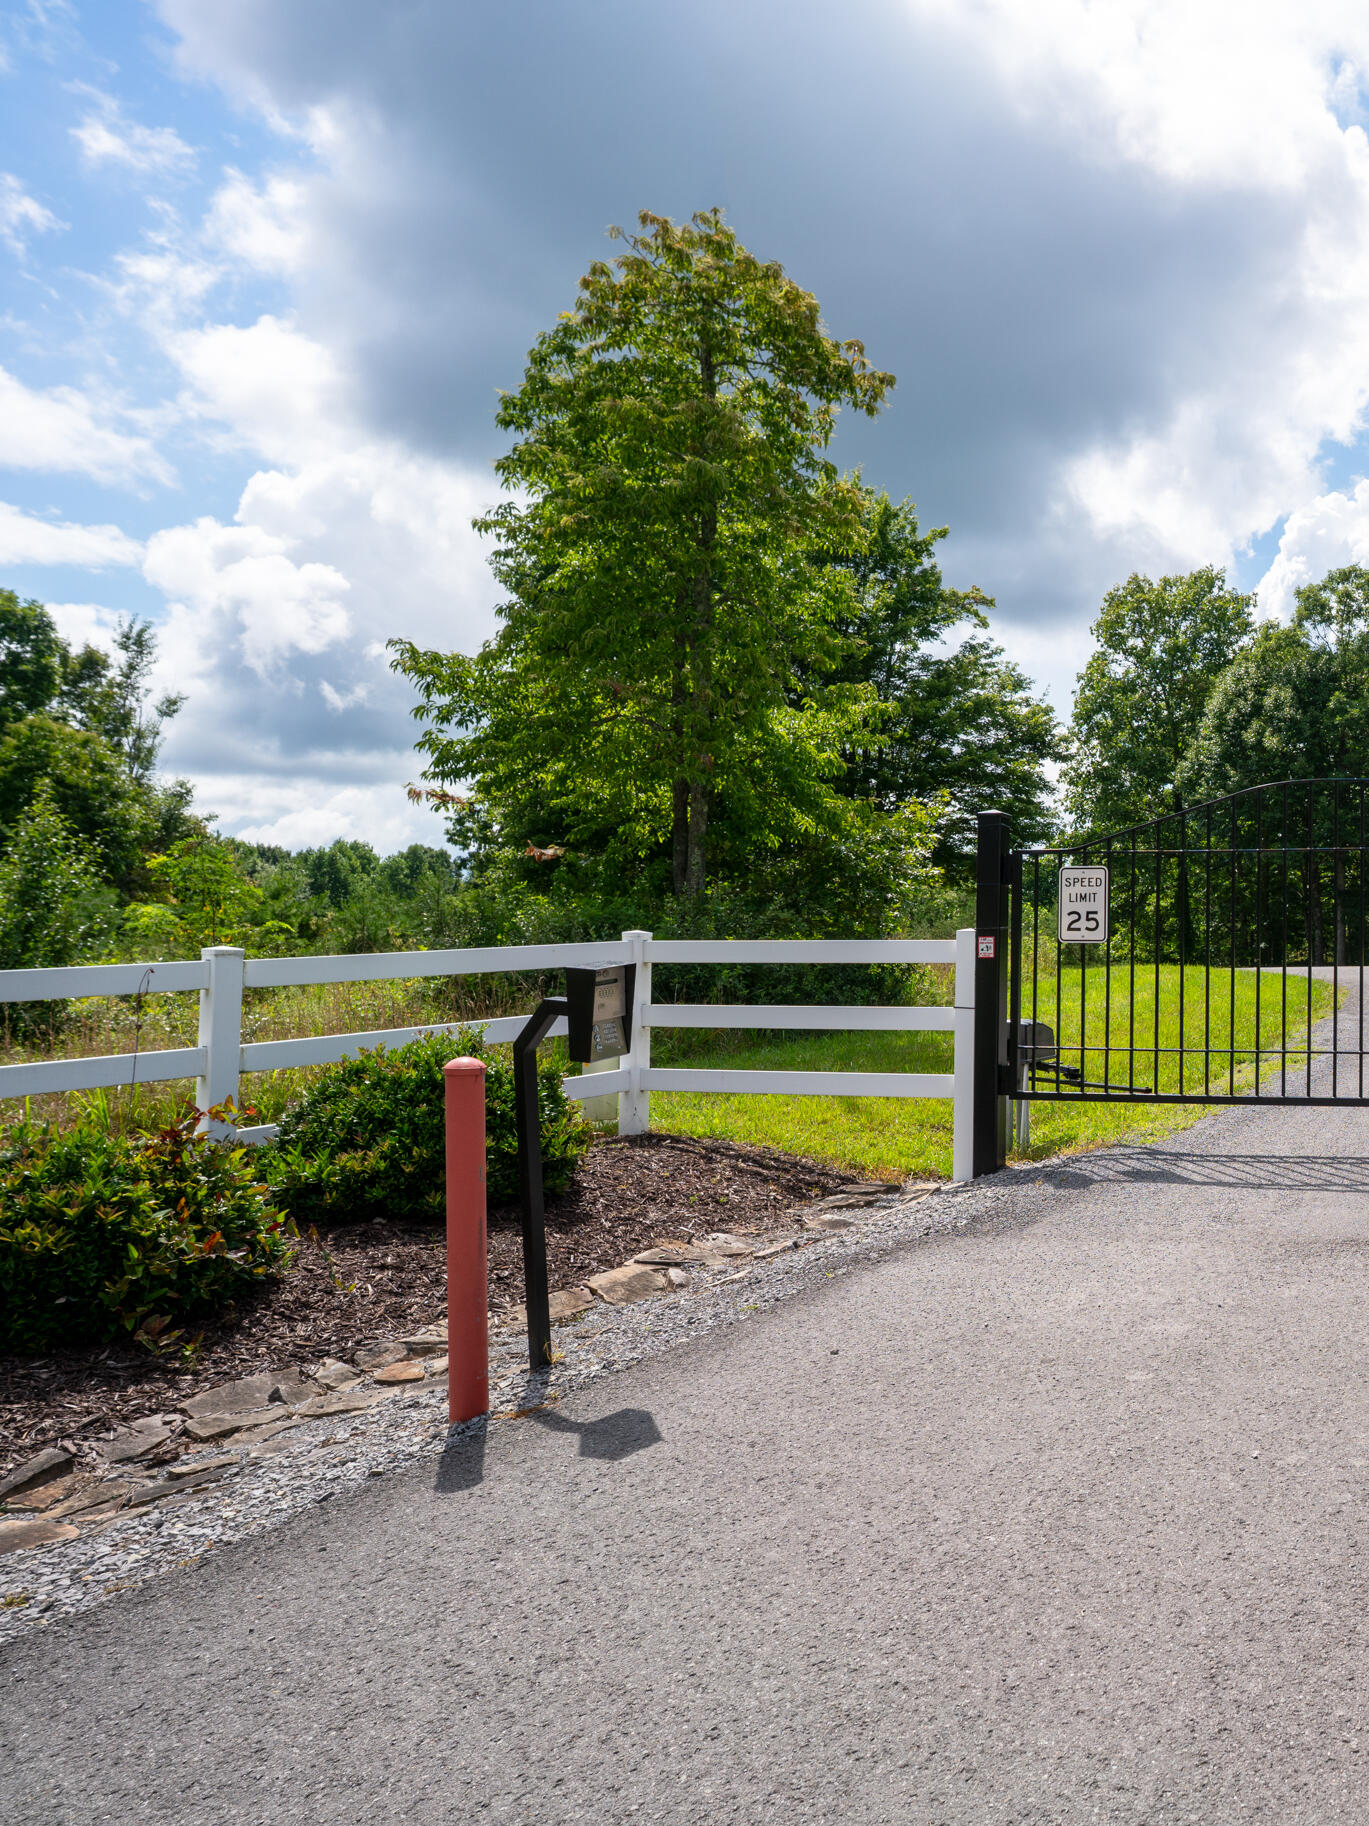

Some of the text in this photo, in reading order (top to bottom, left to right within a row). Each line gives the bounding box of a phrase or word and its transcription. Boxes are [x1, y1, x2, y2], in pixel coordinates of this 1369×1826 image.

[1064, 877, 1102, 888] SPEED
[1068, 892, 1098, 903] LIMIT
[1066, 910, 1100, 932] 25
